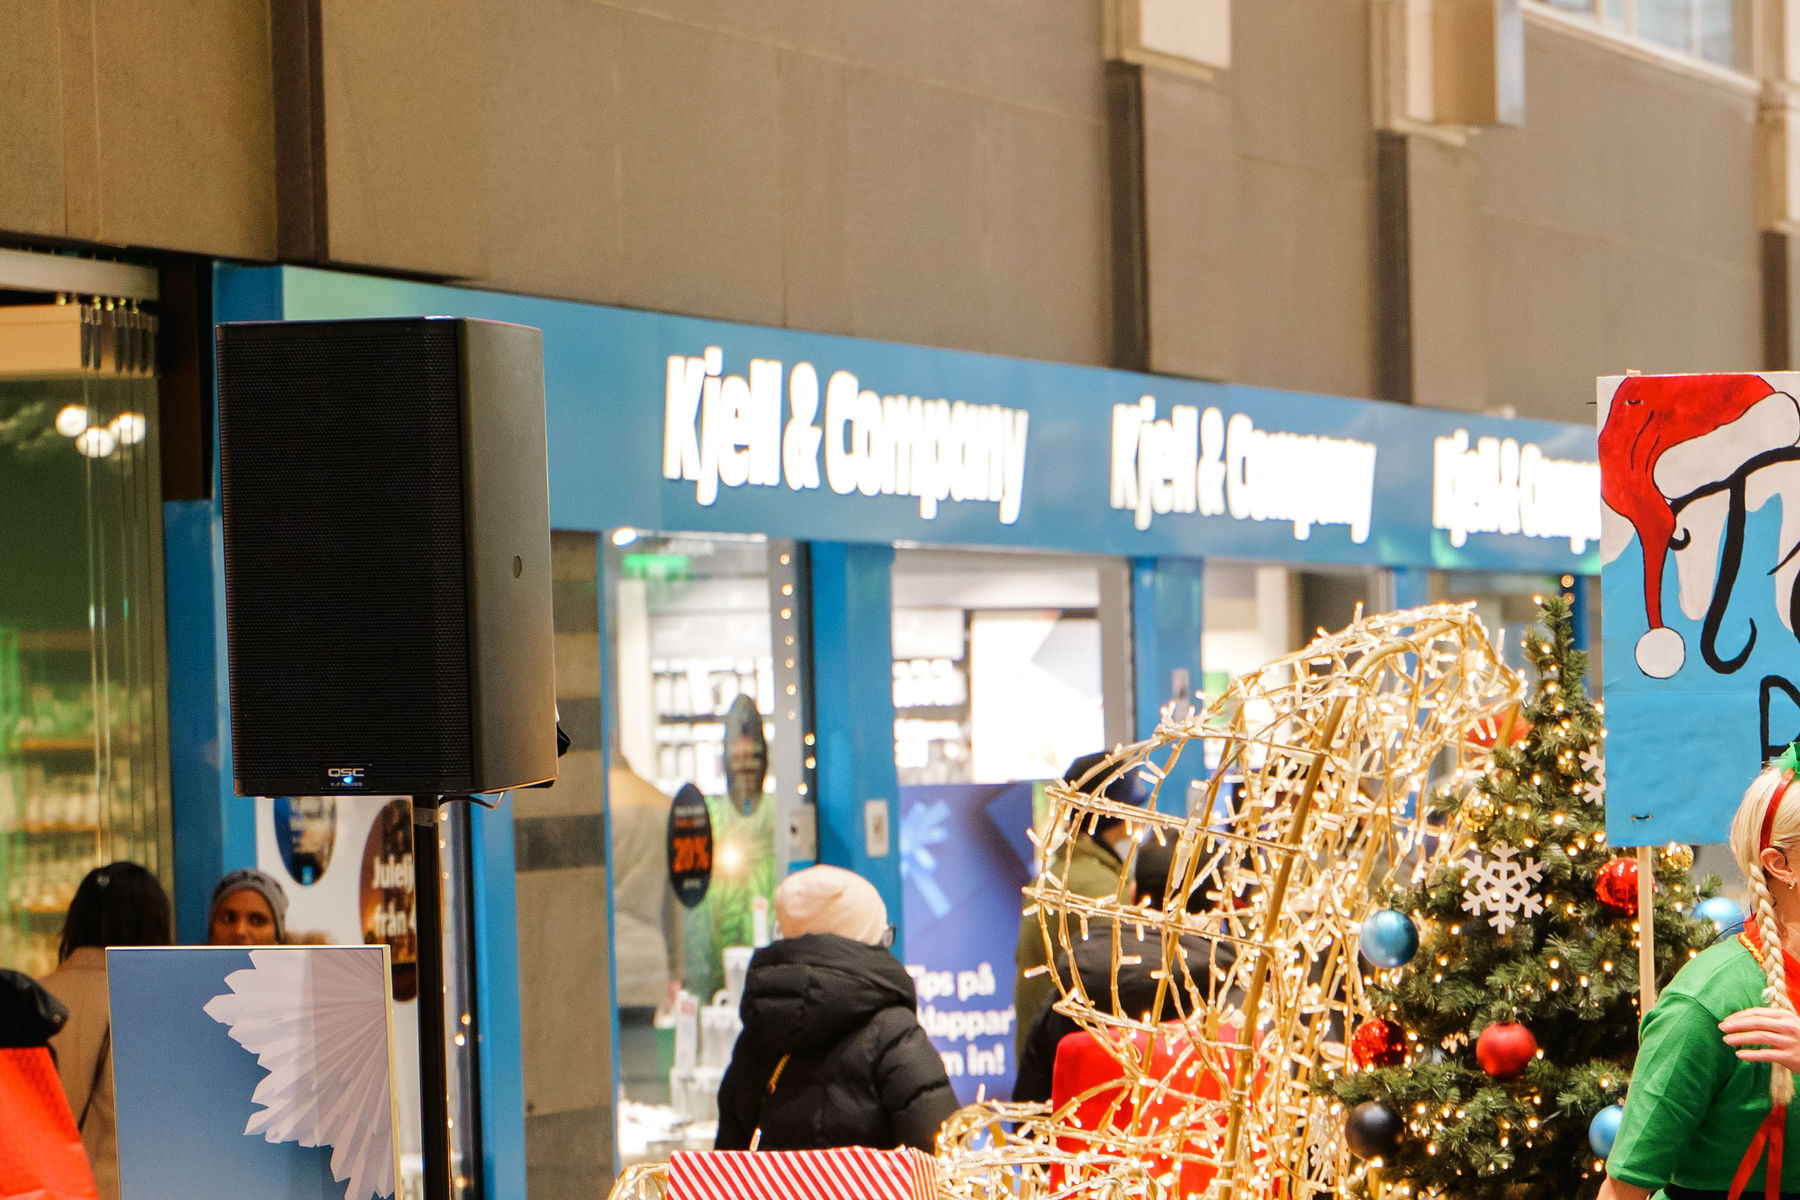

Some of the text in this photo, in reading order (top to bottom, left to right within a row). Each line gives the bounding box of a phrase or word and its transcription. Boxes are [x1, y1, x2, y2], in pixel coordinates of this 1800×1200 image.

[663, 346, 1029, 525] Kjell & Company
[1110, 394, 1377, 544] Kjell & Company
[327, 768, 365, 777] QSC
[957, 962, 996, 1002] på
